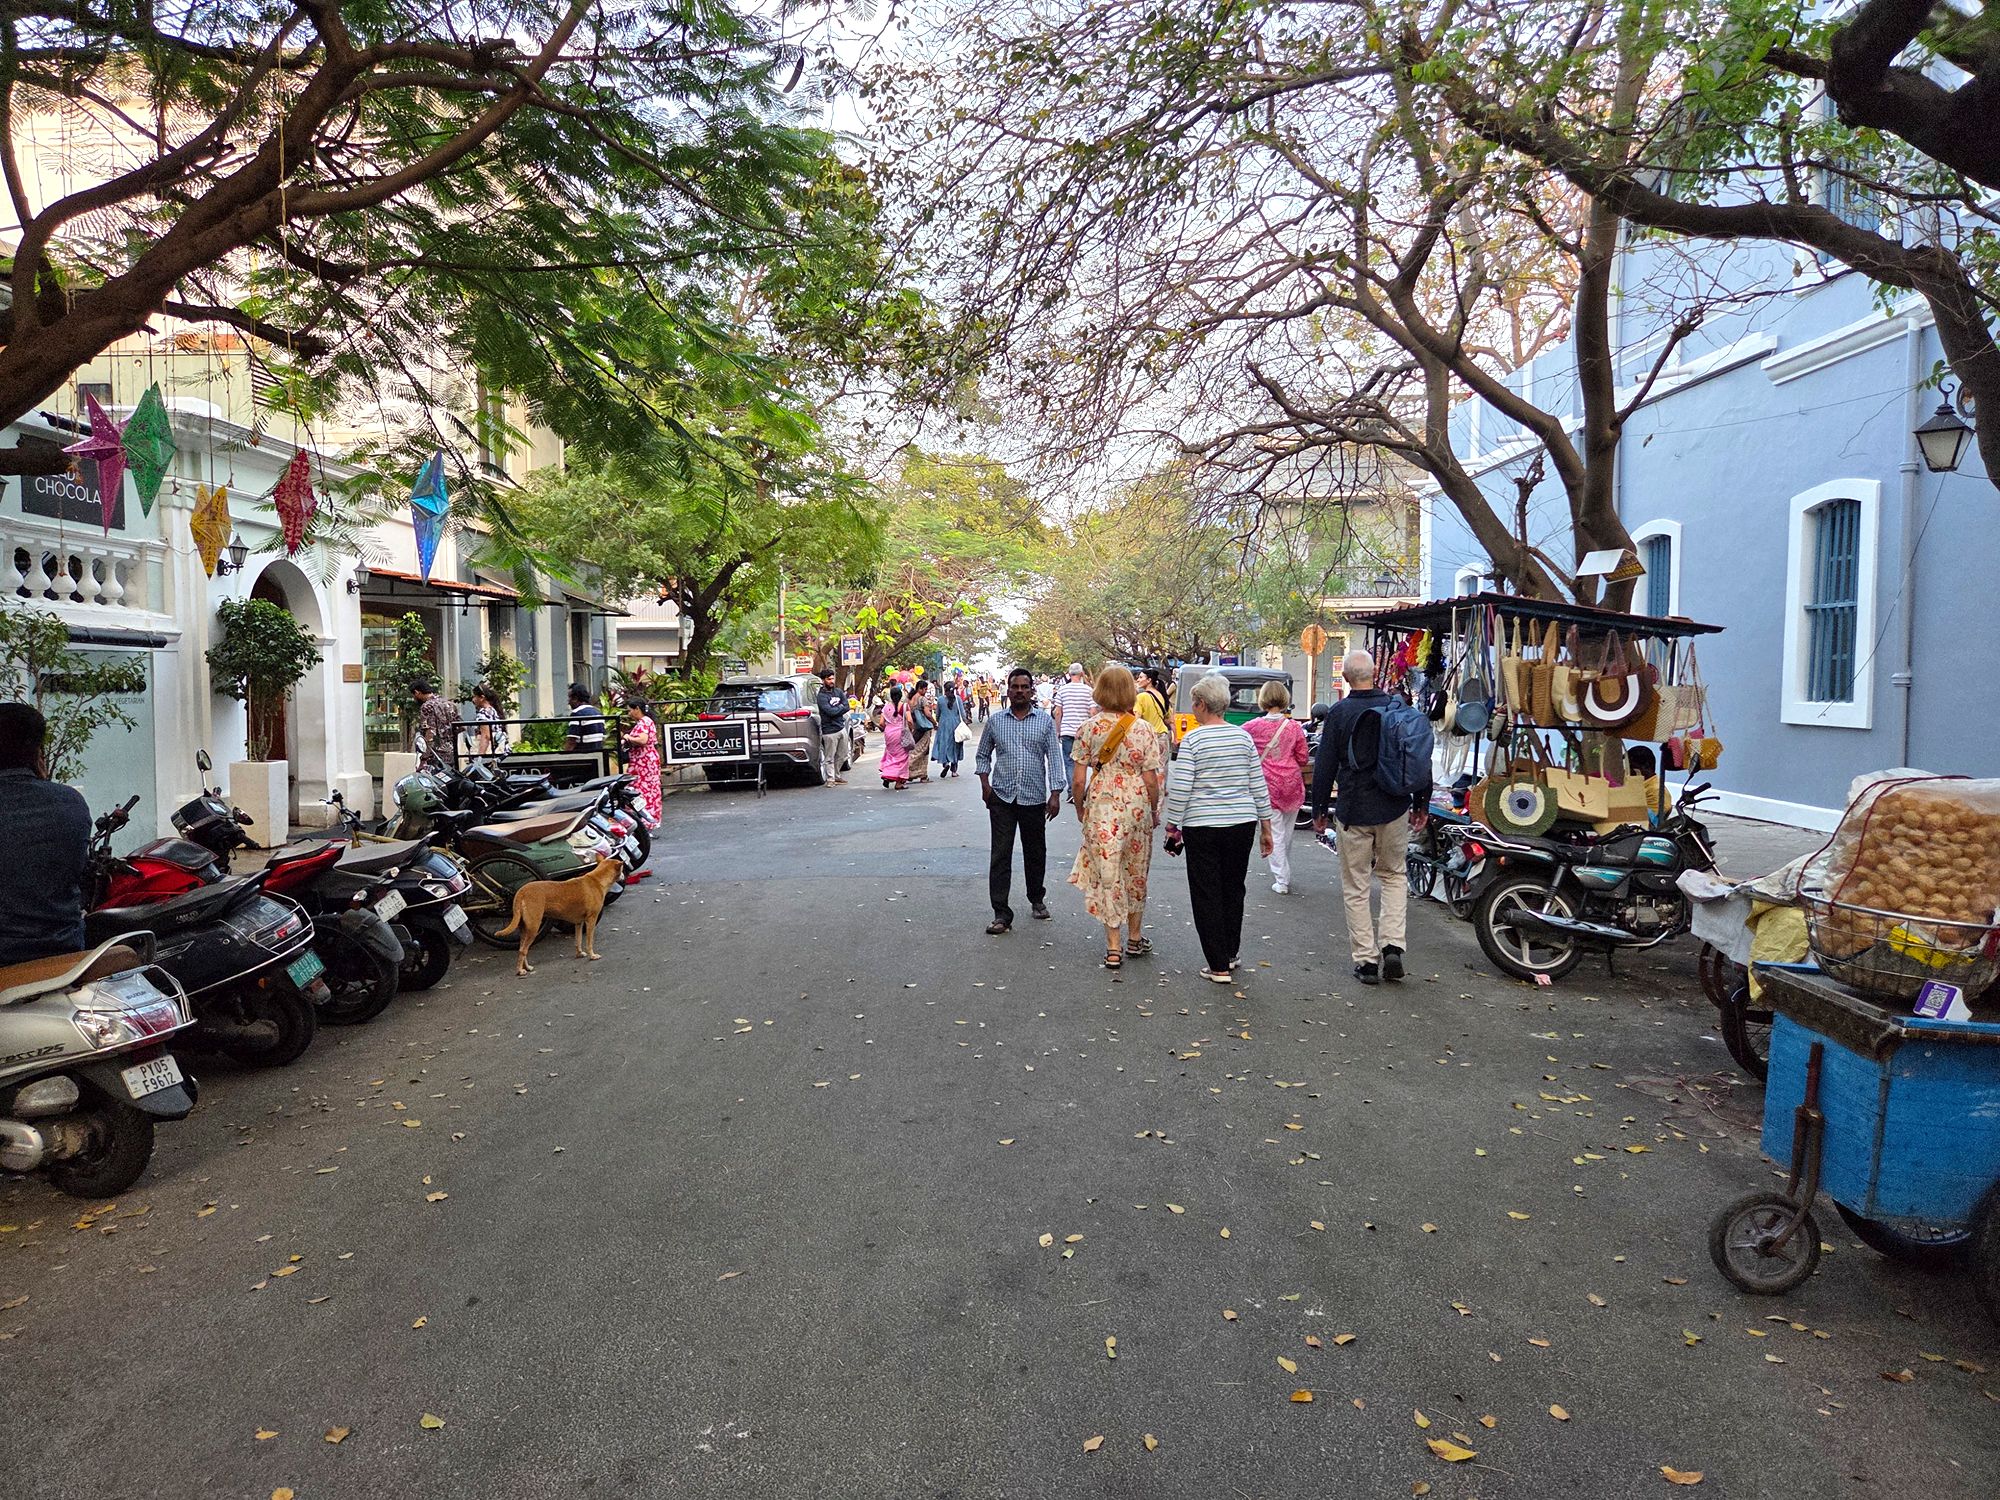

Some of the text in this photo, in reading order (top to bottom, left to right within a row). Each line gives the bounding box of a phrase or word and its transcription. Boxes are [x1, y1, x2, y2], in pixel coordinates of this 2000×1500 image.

[35, 477, 102, 505] CHOCOLA
[674, 738, 742, 751] CHOCOLATE
[140, 1060, 168, 1078] PY05
[142, 1072, 176, 1092] F9612
